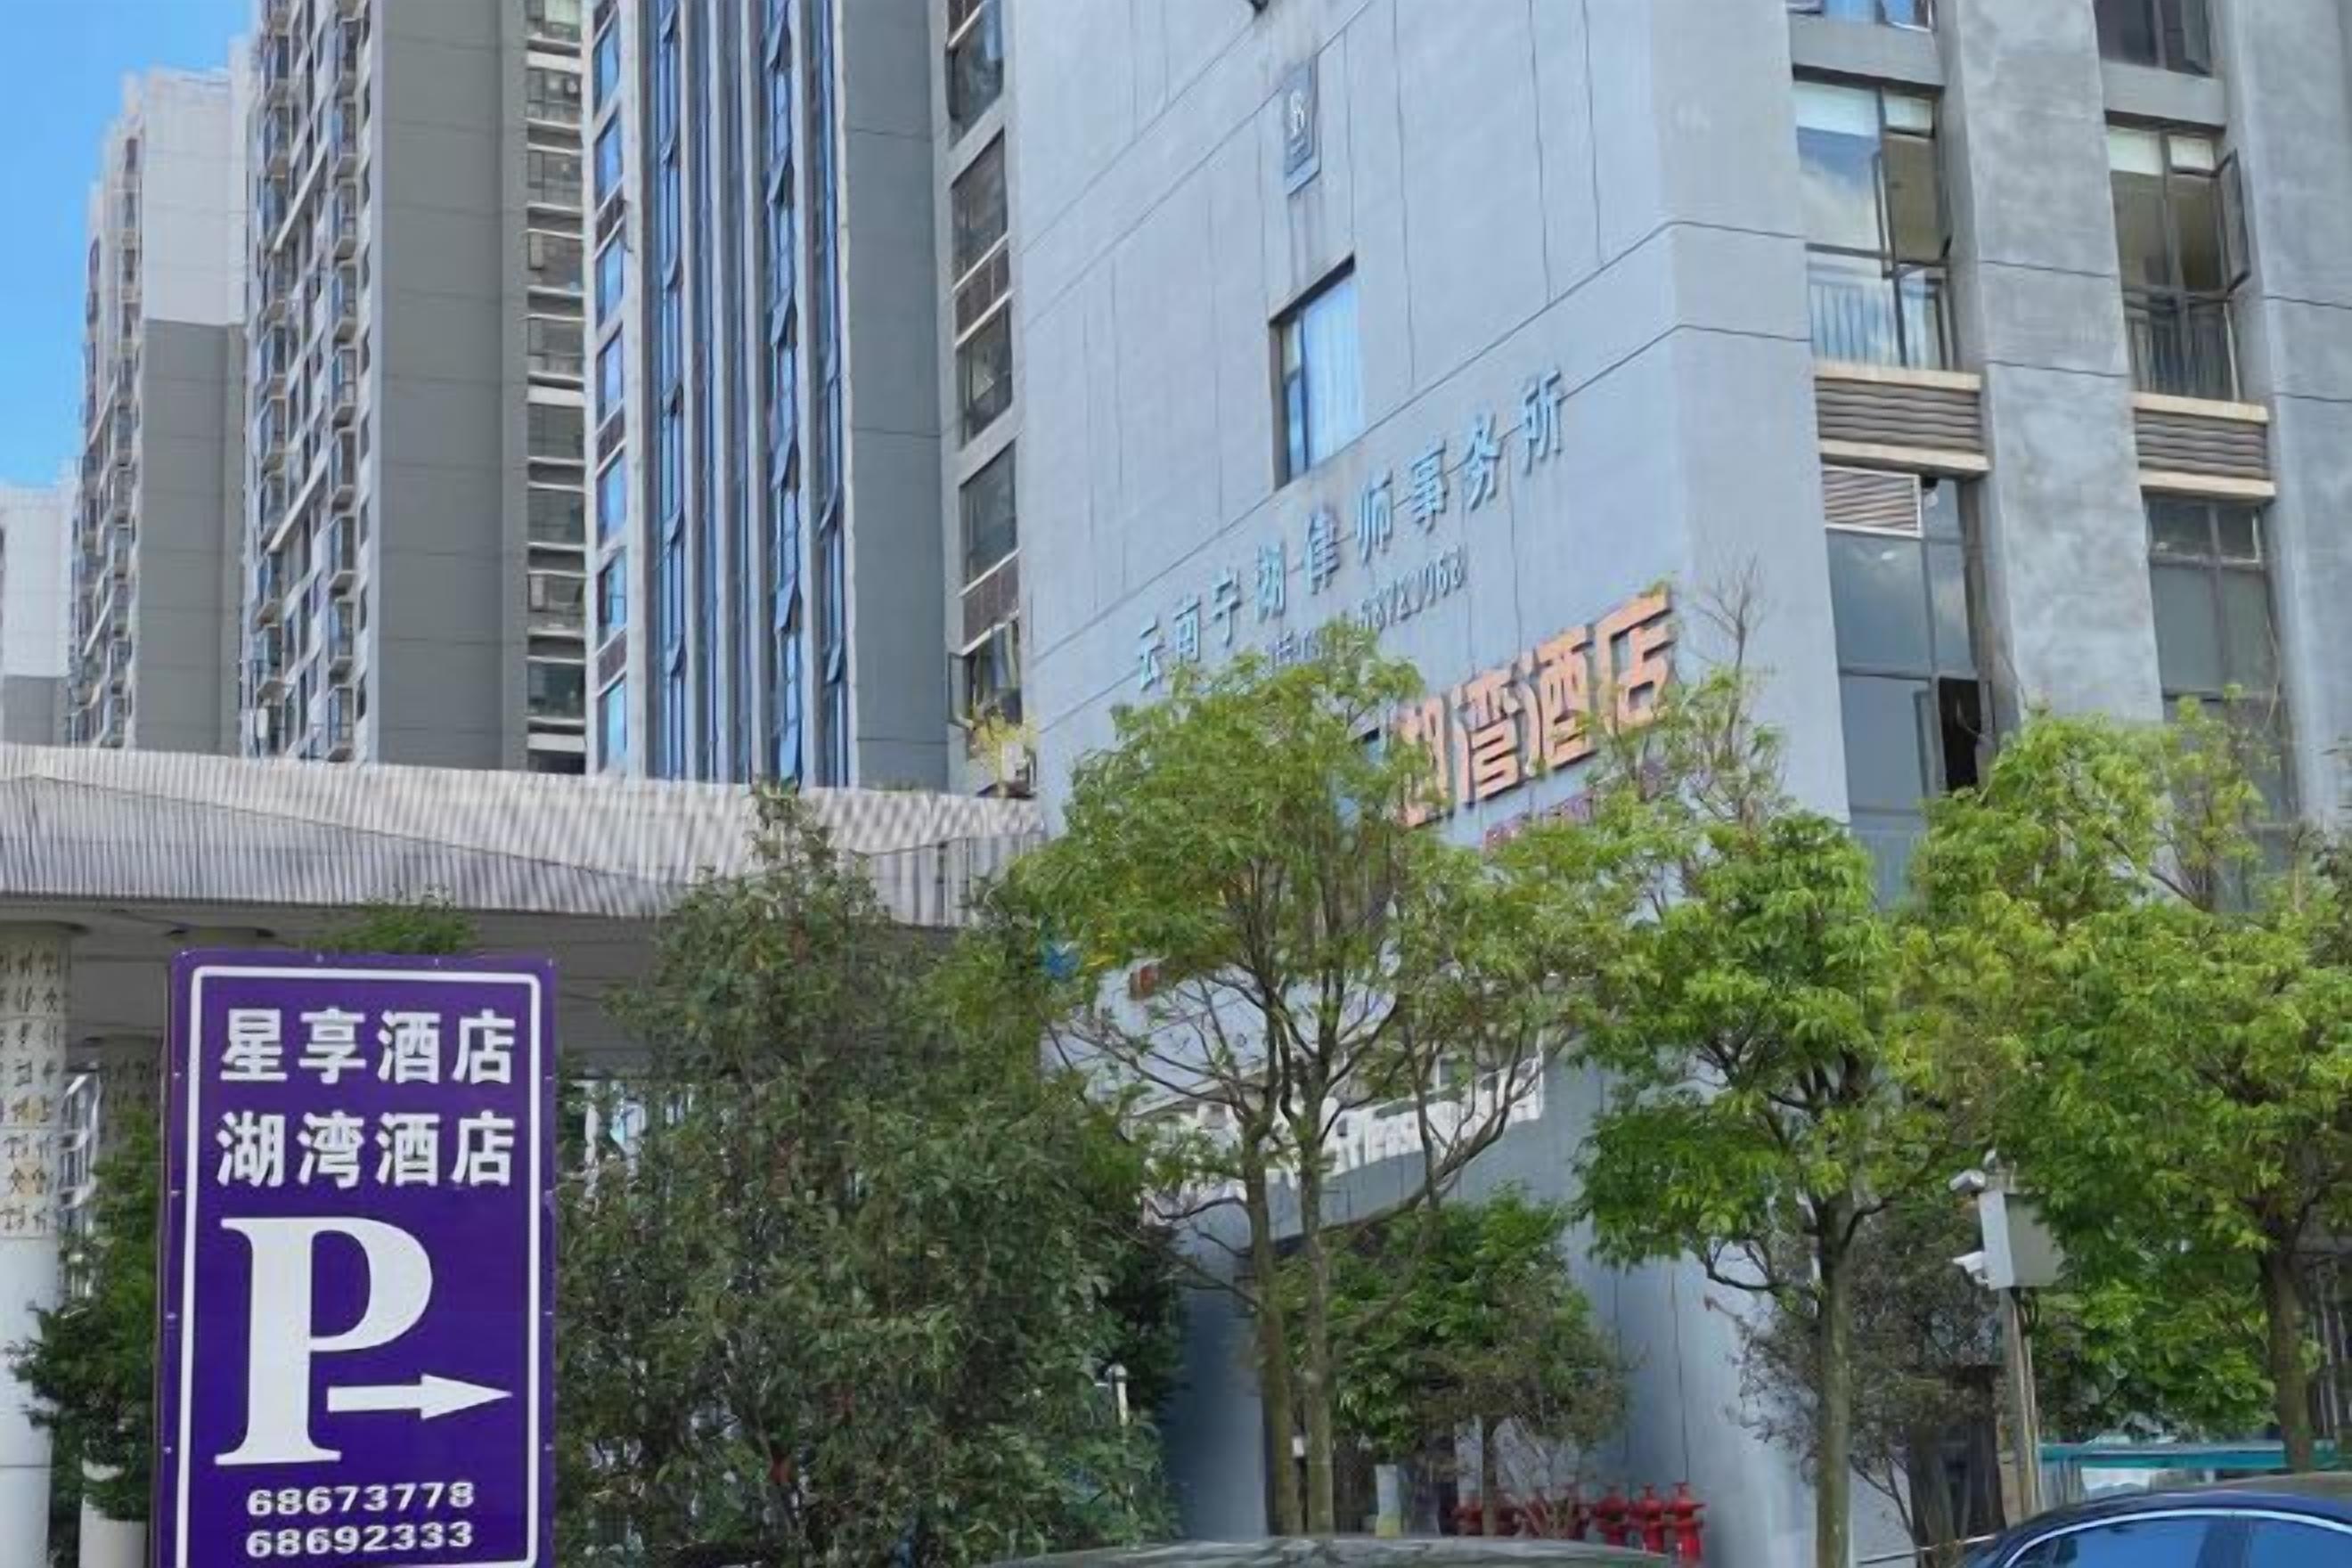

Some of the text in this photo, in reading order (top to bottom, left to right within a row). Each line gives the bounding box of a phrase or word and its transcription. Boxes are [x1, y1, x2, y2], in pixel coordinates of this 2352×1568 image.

[220, 1008, 517, 1085] 星享酒店
[216, 1111, 515, 1188] 湖湾酒店
[215, 1217, 434, 1466] P
[247, 1481, 475, 1516] 68673778
[246, 1520, 473, 1558] 68692333
